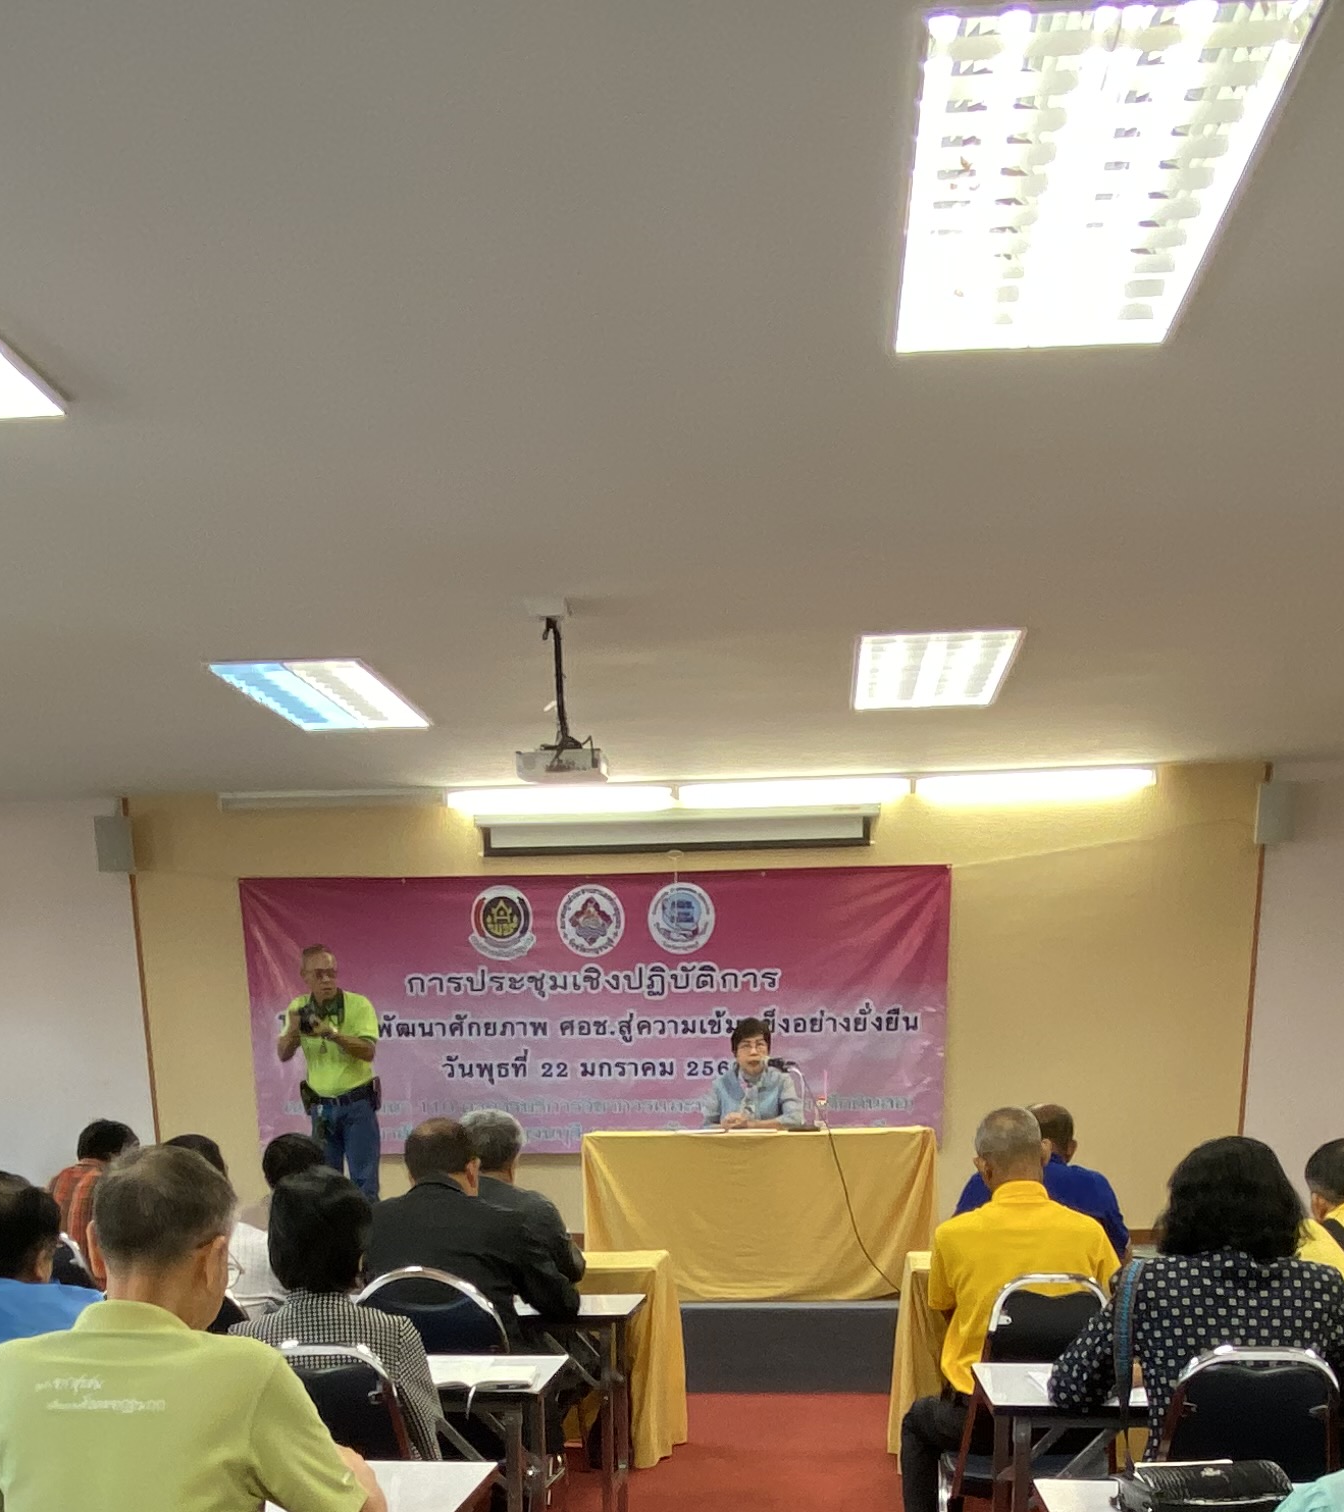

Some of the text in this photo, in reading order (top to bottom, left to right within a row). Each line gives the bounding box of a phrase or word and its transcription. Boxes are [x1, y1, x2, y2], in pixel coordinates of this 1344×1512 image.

[407, 965, 781, 999] การประชุมเชิงปฏิบัติการ
[441, 1049, 738, 1085] วันพุธที่ 22 มกราคม 256
